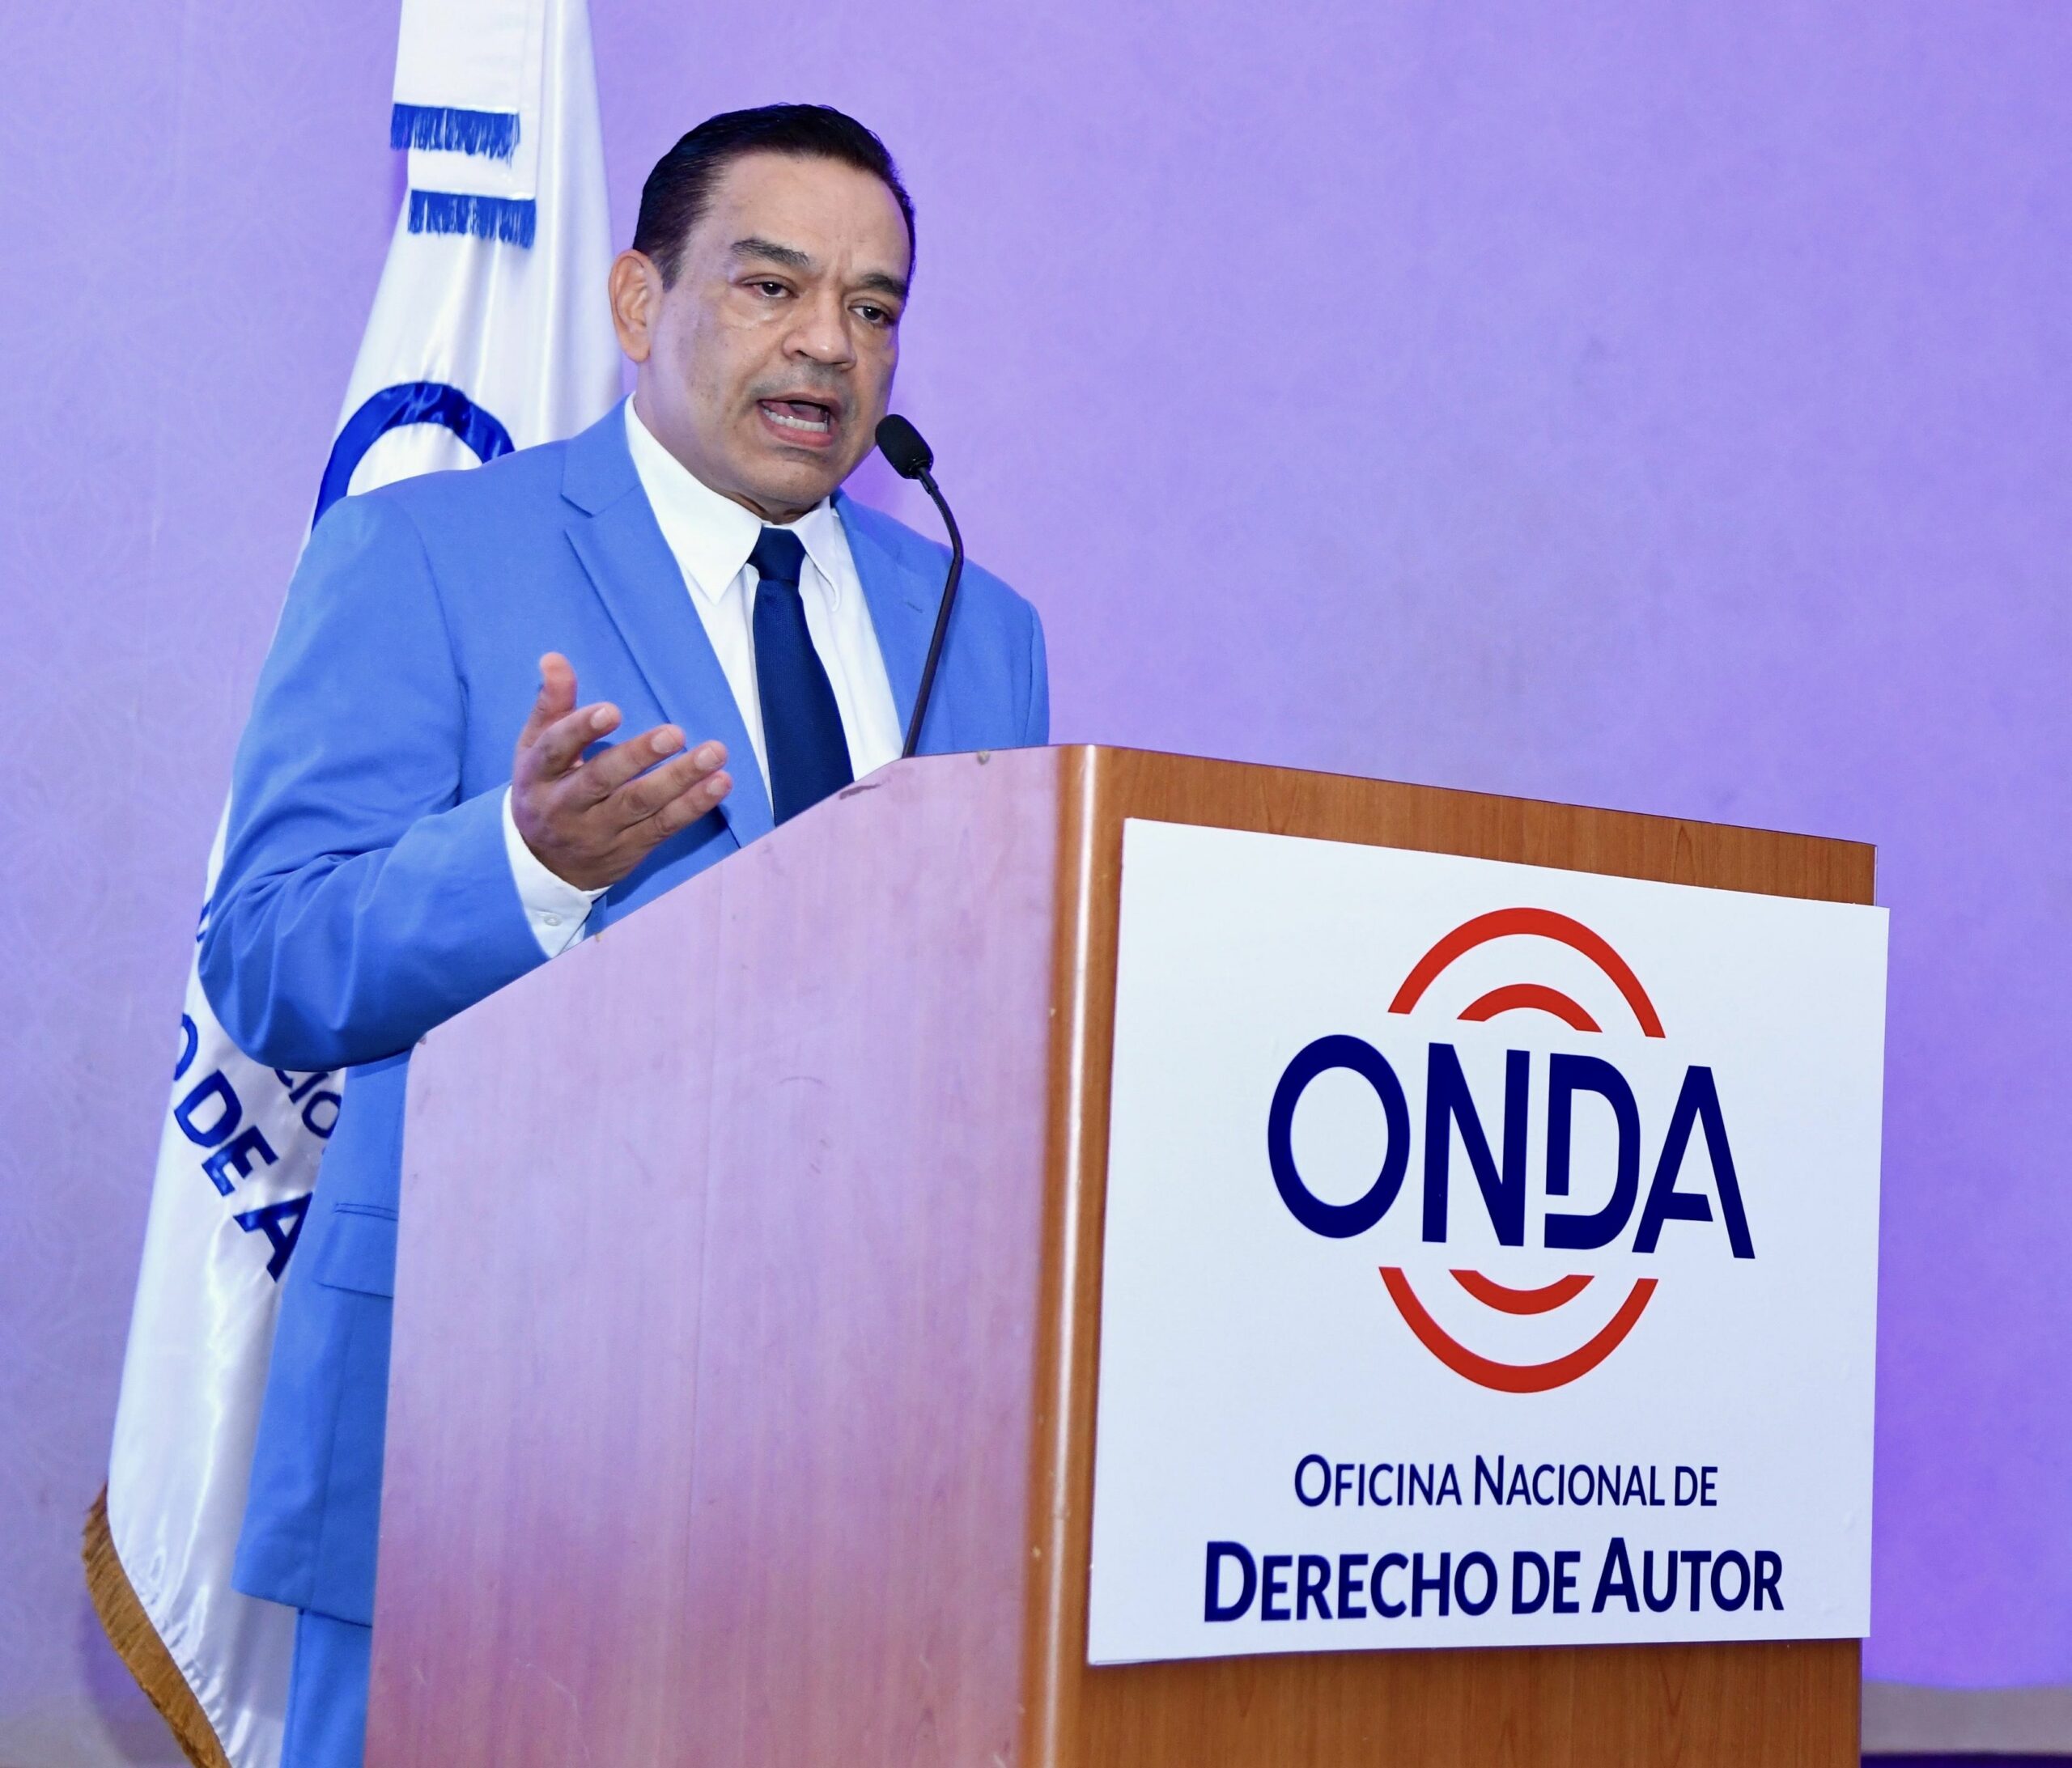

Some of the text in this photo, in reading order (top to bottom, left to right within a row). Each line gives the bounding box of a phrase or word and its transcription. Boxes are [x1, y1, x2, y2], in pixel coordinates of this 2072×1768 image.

[173, 1069, 279, 1197] DE
[1267, 1034, 1756, 1260] ONDA
[1294, 1453, 1718, 1507] OFICINA NACIONAL DE
[1204, 1537, 1785, 1622] DERECHO DE AUTOR
